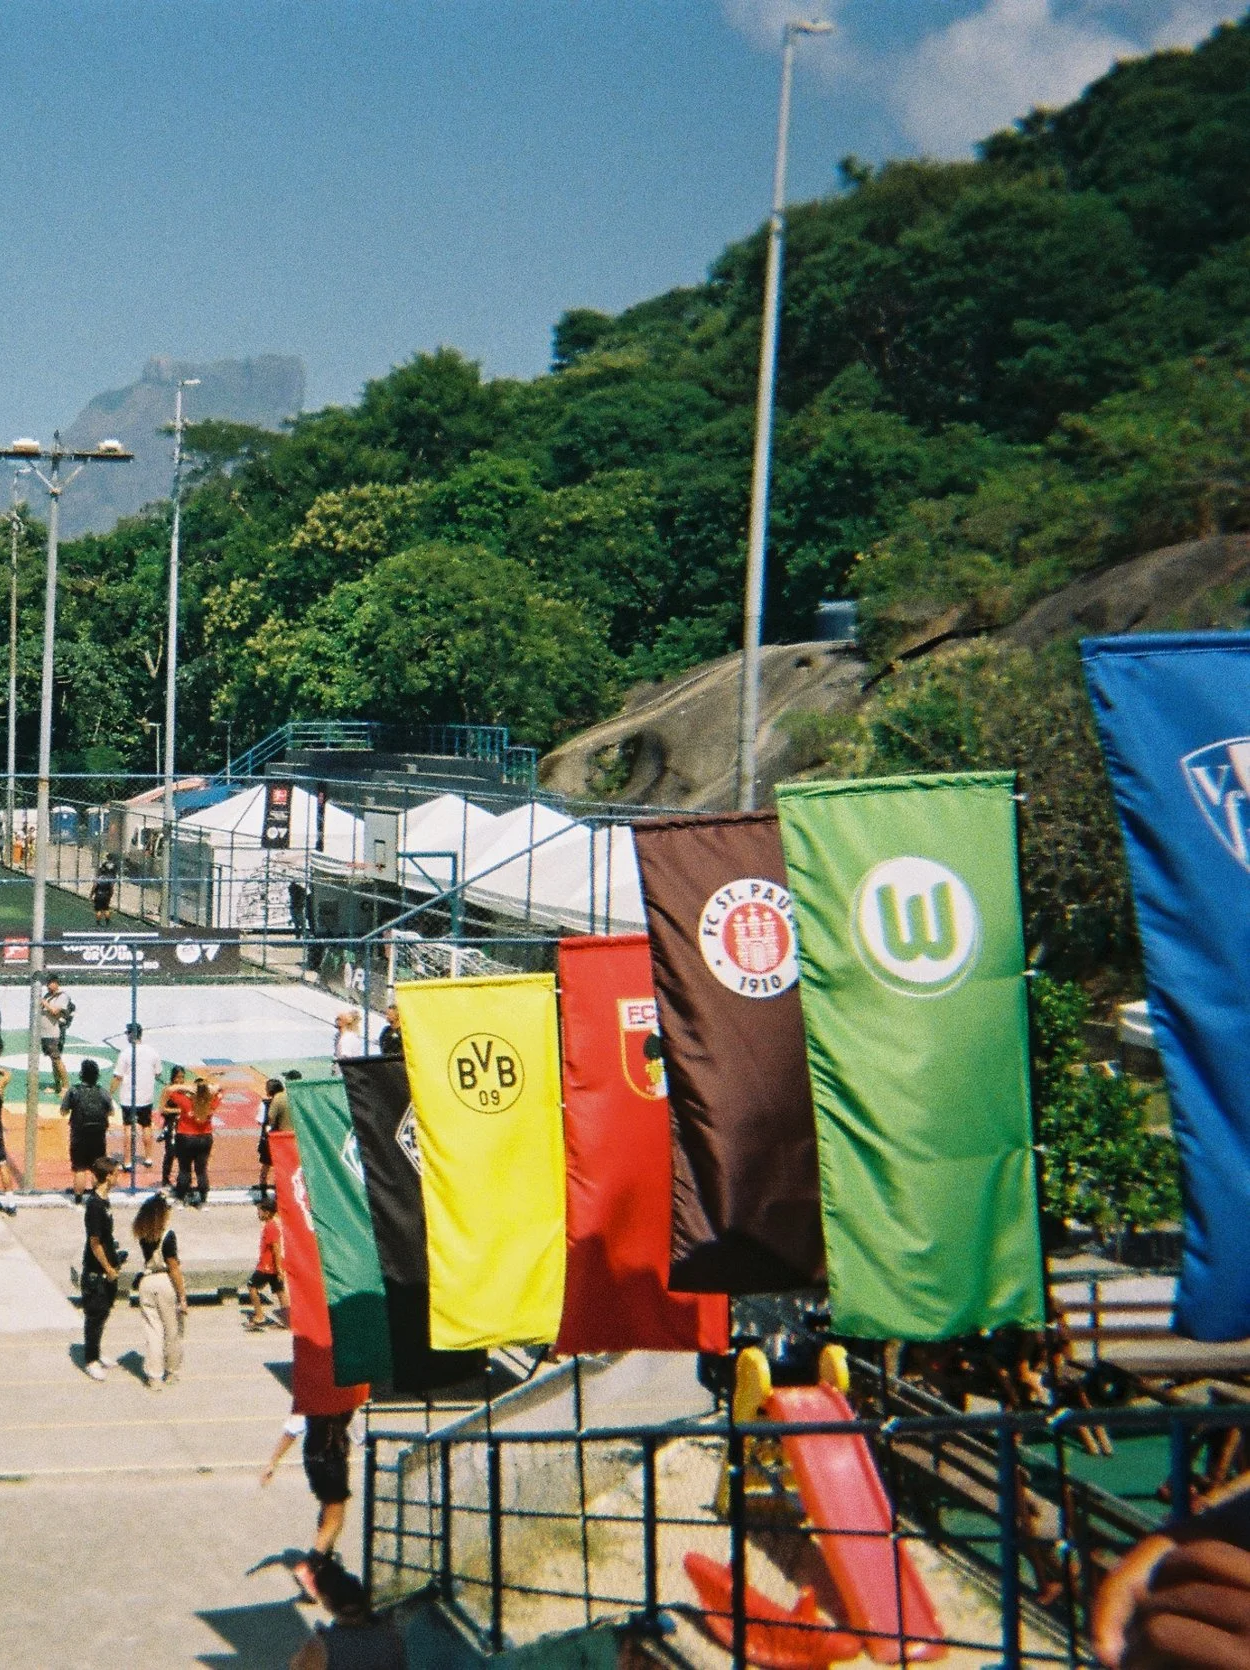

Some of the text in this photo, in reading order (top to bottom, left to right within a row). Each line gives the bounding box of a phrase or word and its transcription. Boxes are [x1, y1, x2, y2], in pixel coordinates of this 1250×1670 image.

[703, 913, 720, 936] FC
[875, 880, 958, 962] W
[739, 974, 782, 994] 1910
[456, 1040, 517, 1090] BVB
[478, 1089, 501, 1107] 09
